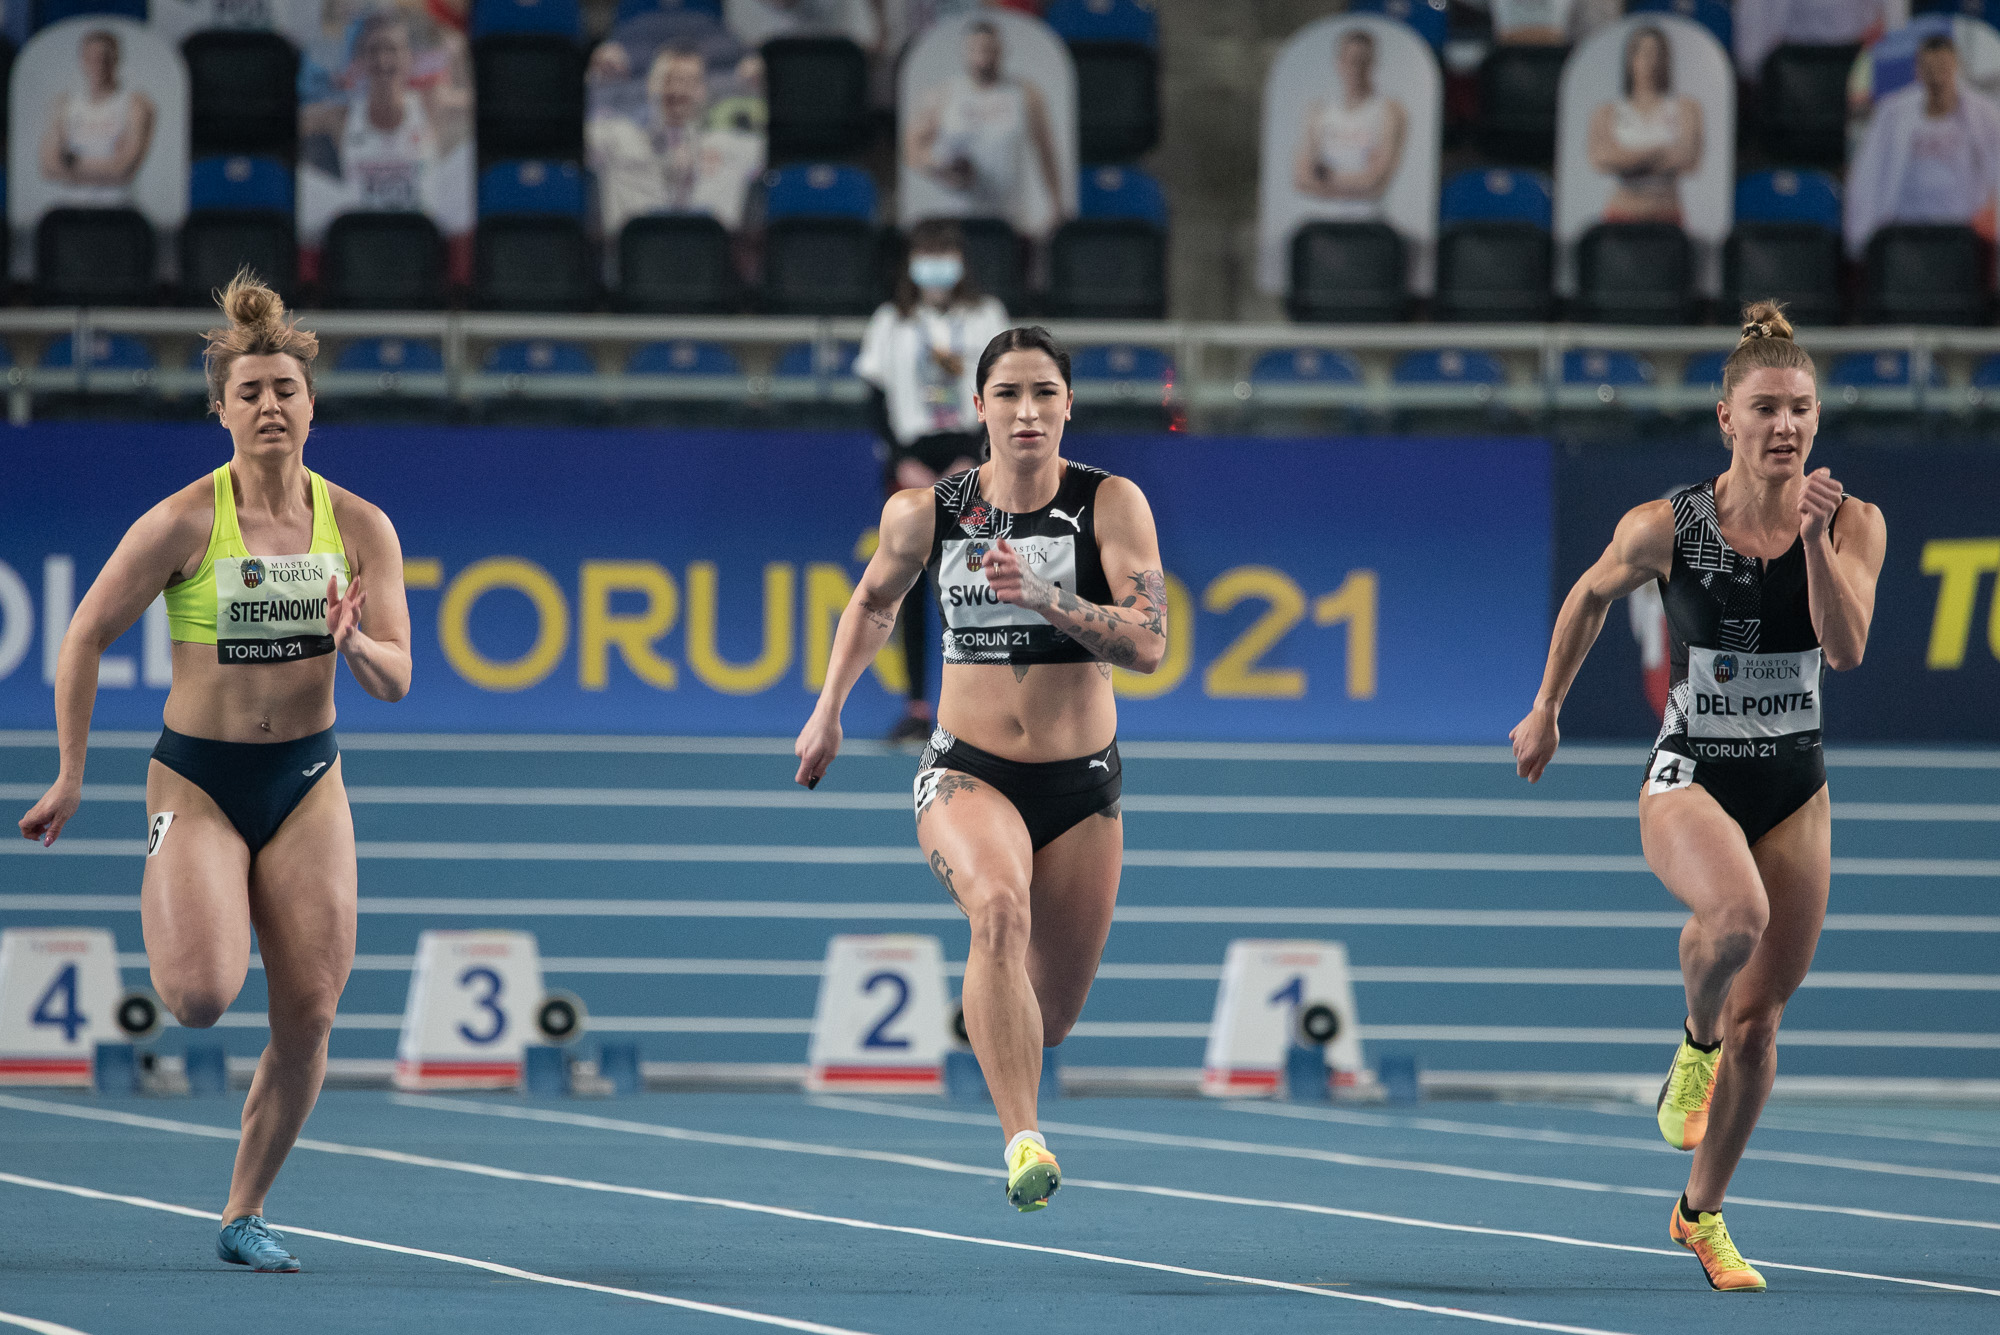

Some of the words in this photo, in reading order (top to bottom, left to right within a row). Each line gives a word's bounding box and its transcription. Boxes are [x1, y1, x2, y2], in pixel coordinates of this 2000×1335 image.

[271, 560, 310, 569] MIASTO
[269, 565, 324, 583] TORUŃ
[1011, 631, 1030, 646] 21
[225, 642, 282, 659] TORUŃ
[285, 641, 302, 657] 21
[1743, 663, 1801, 680] TORUŃ
[1746, 659, 1789, 667] MIASTO
[1696, 693, 1738, 716] DEL
[1742, 690, 1813, 717] PONTE
[1696, 741, 1755, 758] TORUŃ
[1758, 743, 1777, 758] 21
[1655, 758, 1682, 788] 4
[149, 815, 164, 855] 6
[31, 961, 88, 1043] 4
[457, 964, 507, 1046] 3
[862, 970, 911, 1050] 2
